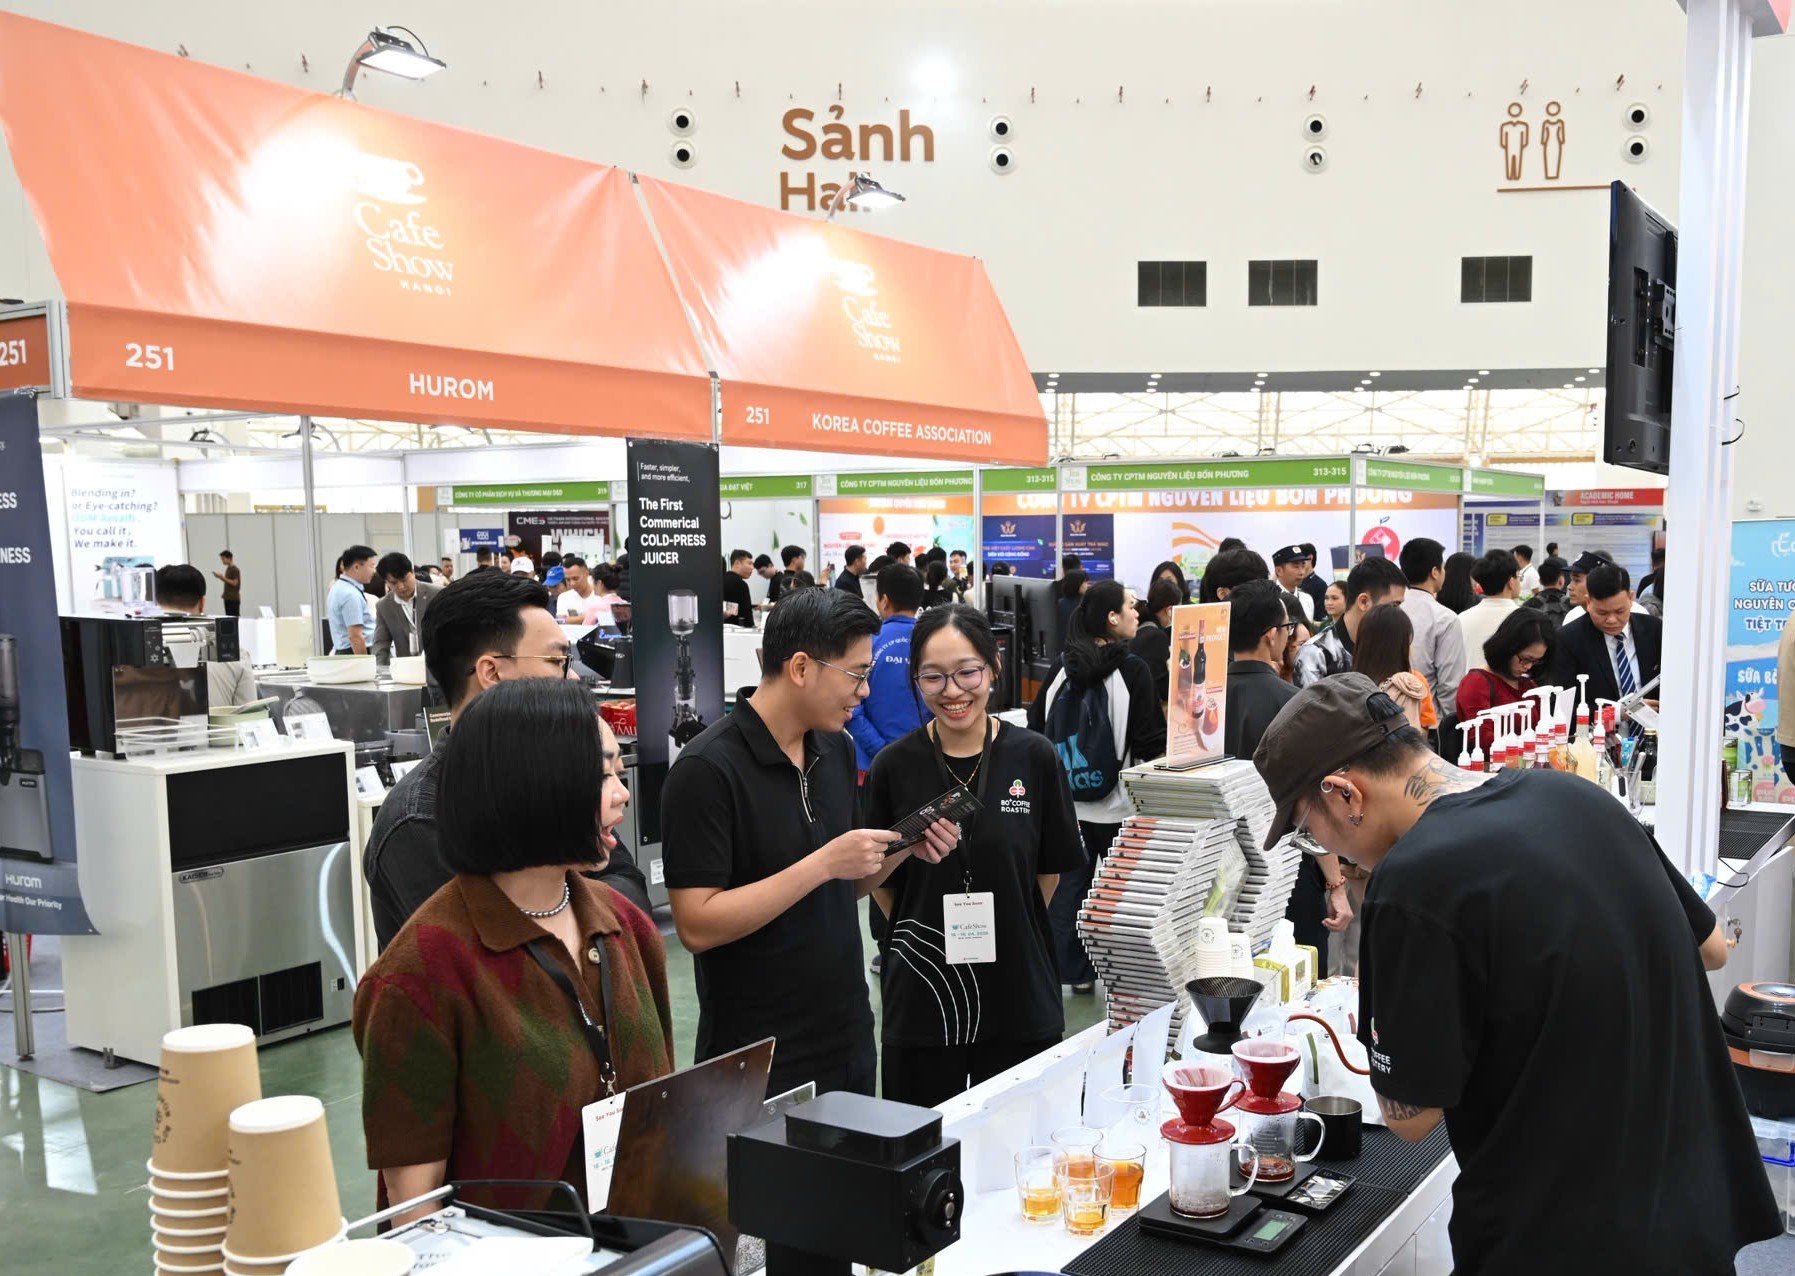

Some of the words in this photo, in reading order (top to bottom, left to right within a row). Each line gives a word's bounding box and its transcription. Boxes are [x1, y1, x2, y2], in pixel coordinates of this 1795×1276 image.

[781, 104, 935, 162] Sảnh
[354, 201, 444, 248] Cafe
[365, 236, 453, 281] Show
[0, 339, 27, 367] 251
[125, 342, 175, 372] 251
[408, 373, 495, 402] HUROM
[745, 406, 770, 426] 251
[812, 413, 860, 433] KOREA
[863, 418, 913, 438] COFFEE
[916, 426, 992, 446] ASSOCIATION
[640, 462, 659, 472] Faster,
[659, 463, 682, 473] simpler,
[1313, 467, 1347, 476] 313-315
[1026, 474, 1055, 484] 313-315
[1091, 472, 1112, 481] CÔNG
[1113, 473, 1122, 481] TY
[1124, 473, 1146, 481] CPTM
[1179, 471, 1196, 481] LIỆU
[1215, 469, 1249, 479] PHƯƠNG
[796, 481, 807, 489] 317
[840, 479, 858, 488] CÔNG
[868, 479, 886, 487] CPTM
[71, 489, 118, 500] Blending
[120, 488, 136, 498] in?
[1580, 491, 1614, 500] ACADEMIC
[1614, 491, 1634, 500] HOME
[85, 501, 158, 513] Eye-catching?
[639, 497, 659, 510] The
[660, 498, 684, 511] First
[639, 515, 700, 529] Commerical
[73, 527, 93, 536] You
[96, 526, 116, 536] call
[74, 539, 90, 548] We
[93, 539, 123, 548] make
[640, 533, 707, 547] COLD-PRESS
[0, 546, 31, 564] NESS
[641, 551, 679, 564] JUICER
[1750, 579, 1774, 593] SỮA
[1734, 597, 1784, 611] NGUYÊN
[1746, 616, 1771, 631] TIỆT
[1738, 666, 1761, 684] SỮA
[25, 896, 37, 906] Our
[37, 898, 62, 911] Priority
